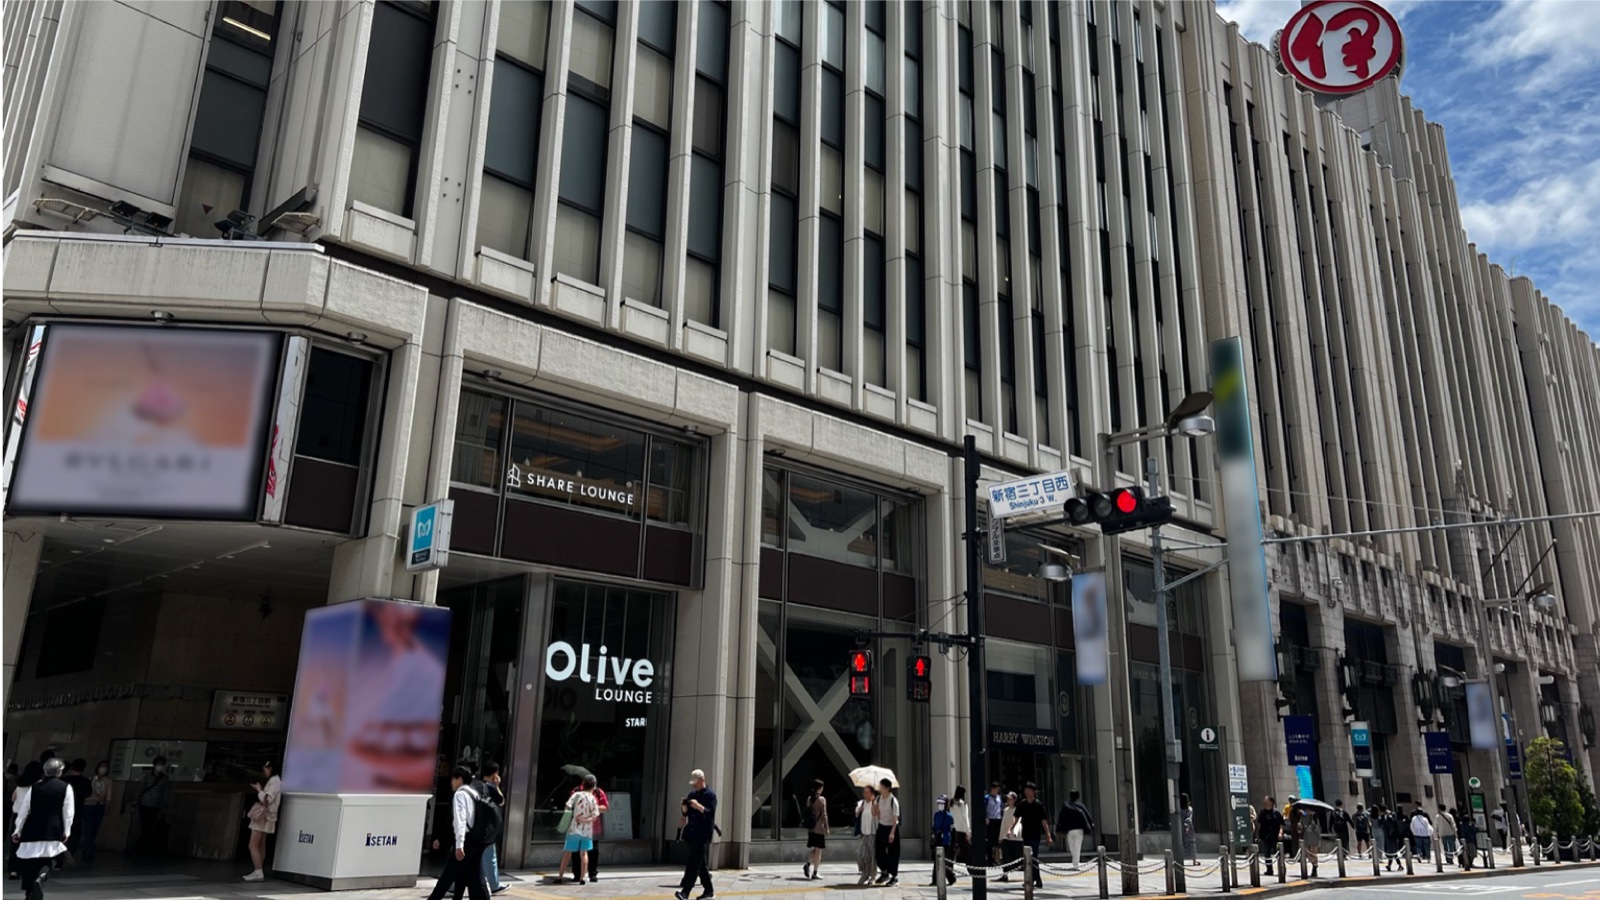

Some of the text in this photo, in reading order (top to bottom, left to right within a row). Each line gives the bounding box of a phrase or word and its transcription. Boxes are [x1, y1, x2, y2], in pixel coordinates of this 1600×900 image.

[527, 472, 634, 506] SHARE LOUNGE
[991, 475, 1069, 503] 新宿三丁目西
[1009, 498, 1039, 510] Shinjuku
[1039, 496, 1045, 504] 3
[545, 640, 655, 688] Olive
[595, 688, 653, 704] LOUNGE
[625, 717, 648, 728] STAR
[993, 731, 1055, 747] HARRY WINSTON
[365, 832, 398, 847] ISETAN
